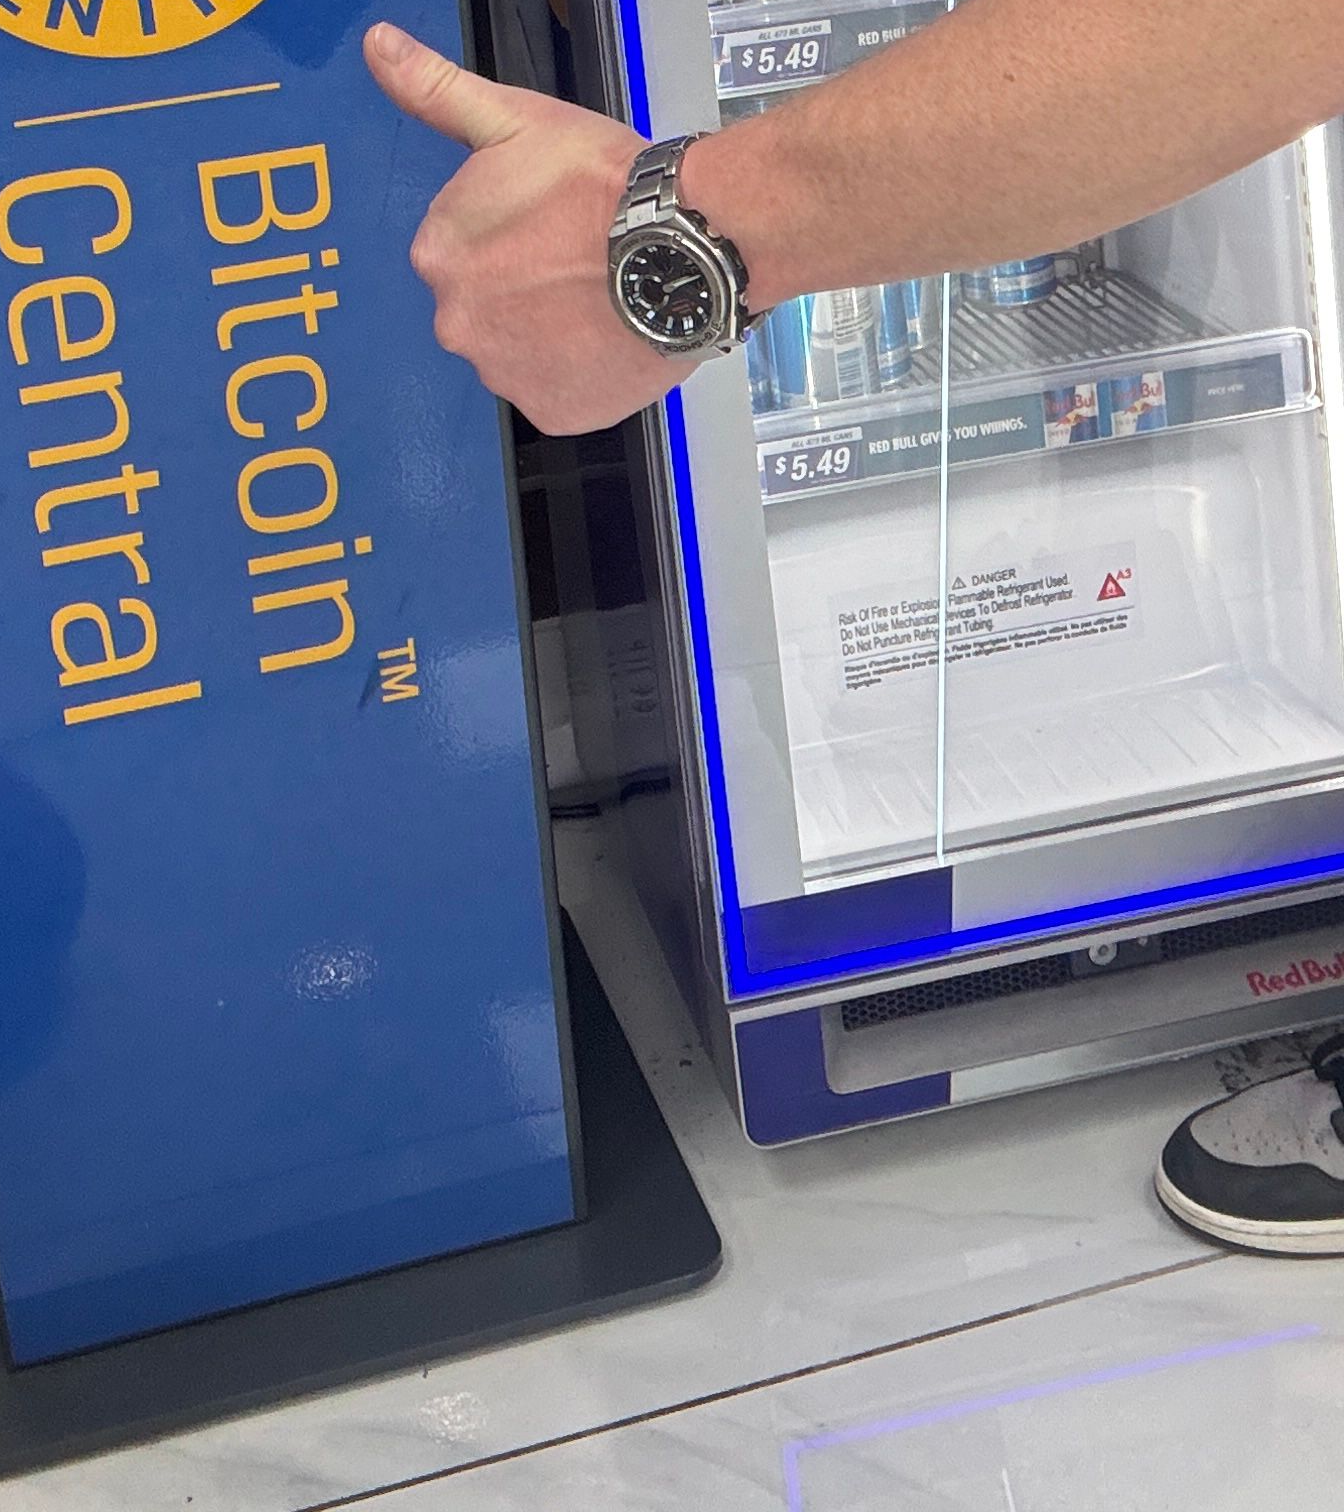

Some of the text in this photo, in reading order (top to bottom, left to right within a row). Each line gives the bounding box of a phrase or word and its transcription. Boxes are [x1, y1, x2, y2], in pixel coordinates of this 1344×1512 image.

[858, 31, 879, 47] RED
[742, 41, 820, 75] $5.49
[197, 143, 374, 674] Bitcoin
[868, 440, 890, 455] RED
[893, 435, 918, 451] BULL
[954, 425, 978, 441] YOU
[775, 446, 850, 481] $5.49
[971, 568, 1017, 586] DANGER
[1116, 568, 1132, 581] A3
[839, 613, 857, 626] Risk
[858, 608, 870, 621] Of
[871, 605, 888, 619] Fire
[890, 605, 899, 615] or
[901, 598, 941, 615] Explosio
[948, 588, 996, 607] Flammable
[997, 578, 1045, 597] Refrigerant
[840, 629, 853, 641] Do
[855, 625, 871, 638] Not
[871, 623, 889, 635] Use
[946, 607, 977, 621] evices
[978, 603, 990, 616] To
[991, 597, 1022, 614] Defrost
[842, 643, 856, 656] Do
[857, 640, 872, 653] Not
[873, 633, 912, 648] Puncture
